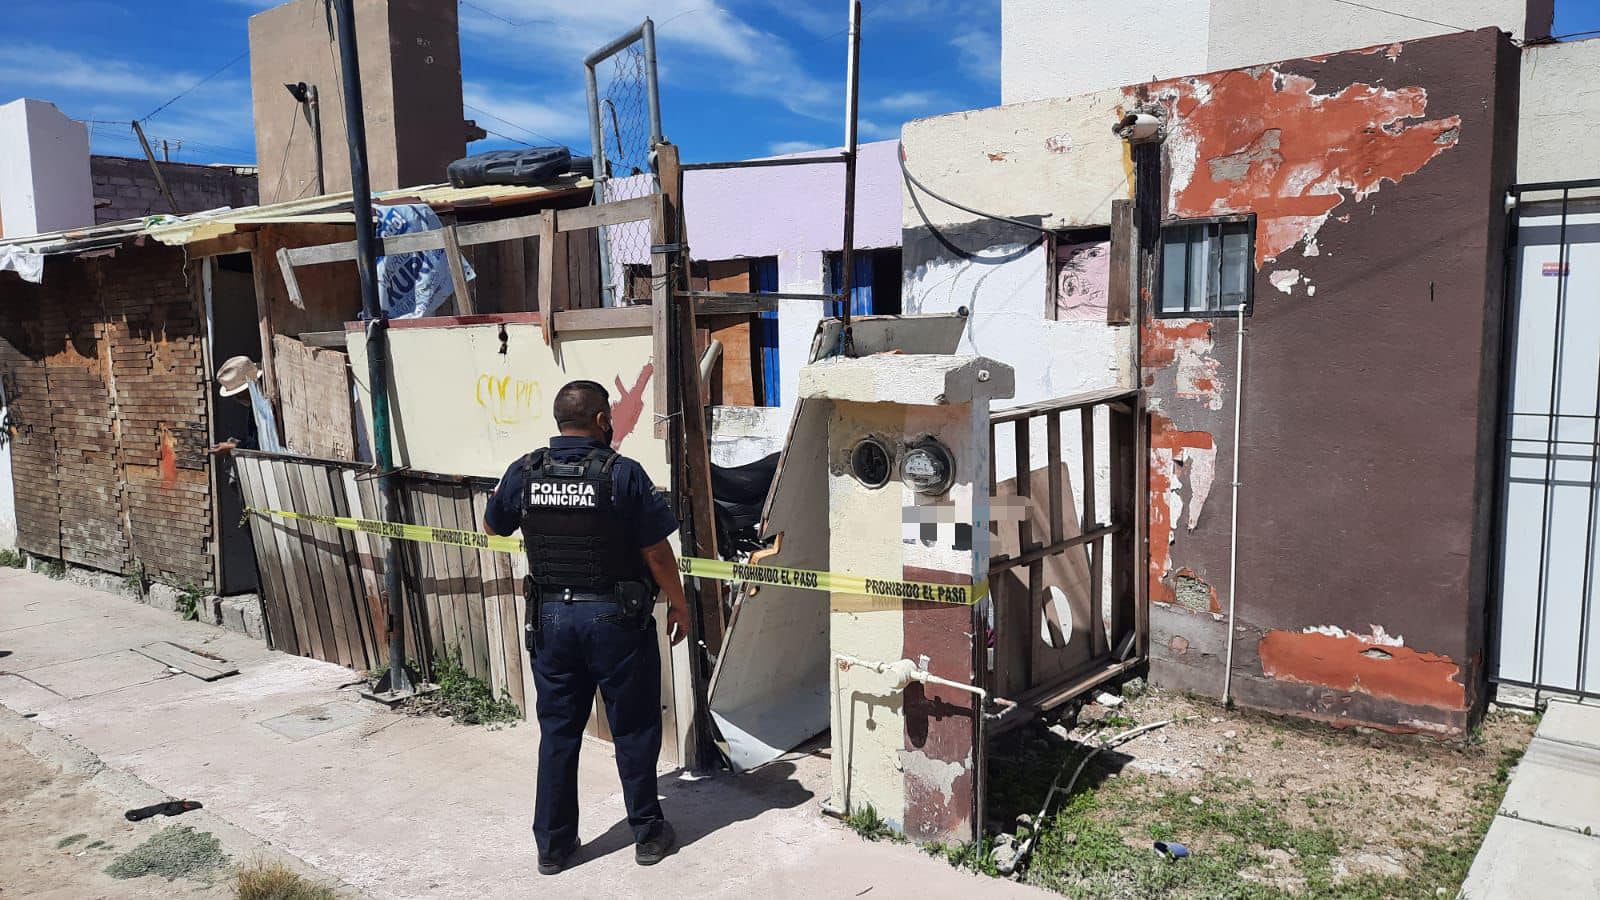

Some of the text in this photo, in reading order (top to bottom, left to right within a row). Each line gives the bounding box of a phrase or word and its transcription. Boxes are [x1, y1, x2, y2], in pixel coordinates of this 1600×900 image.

[531, 482, 595, 496] POLICÍA
[531, 494, 595, 507] MUNICIPAL
[464, 533, 471, 546] EL
[472, 534, 488, 548] PASO
[733, 564, 818, 588] PROHIBIDO EL PASO
[865, 578, 966, 603] PROHIBIDO EL PASO
